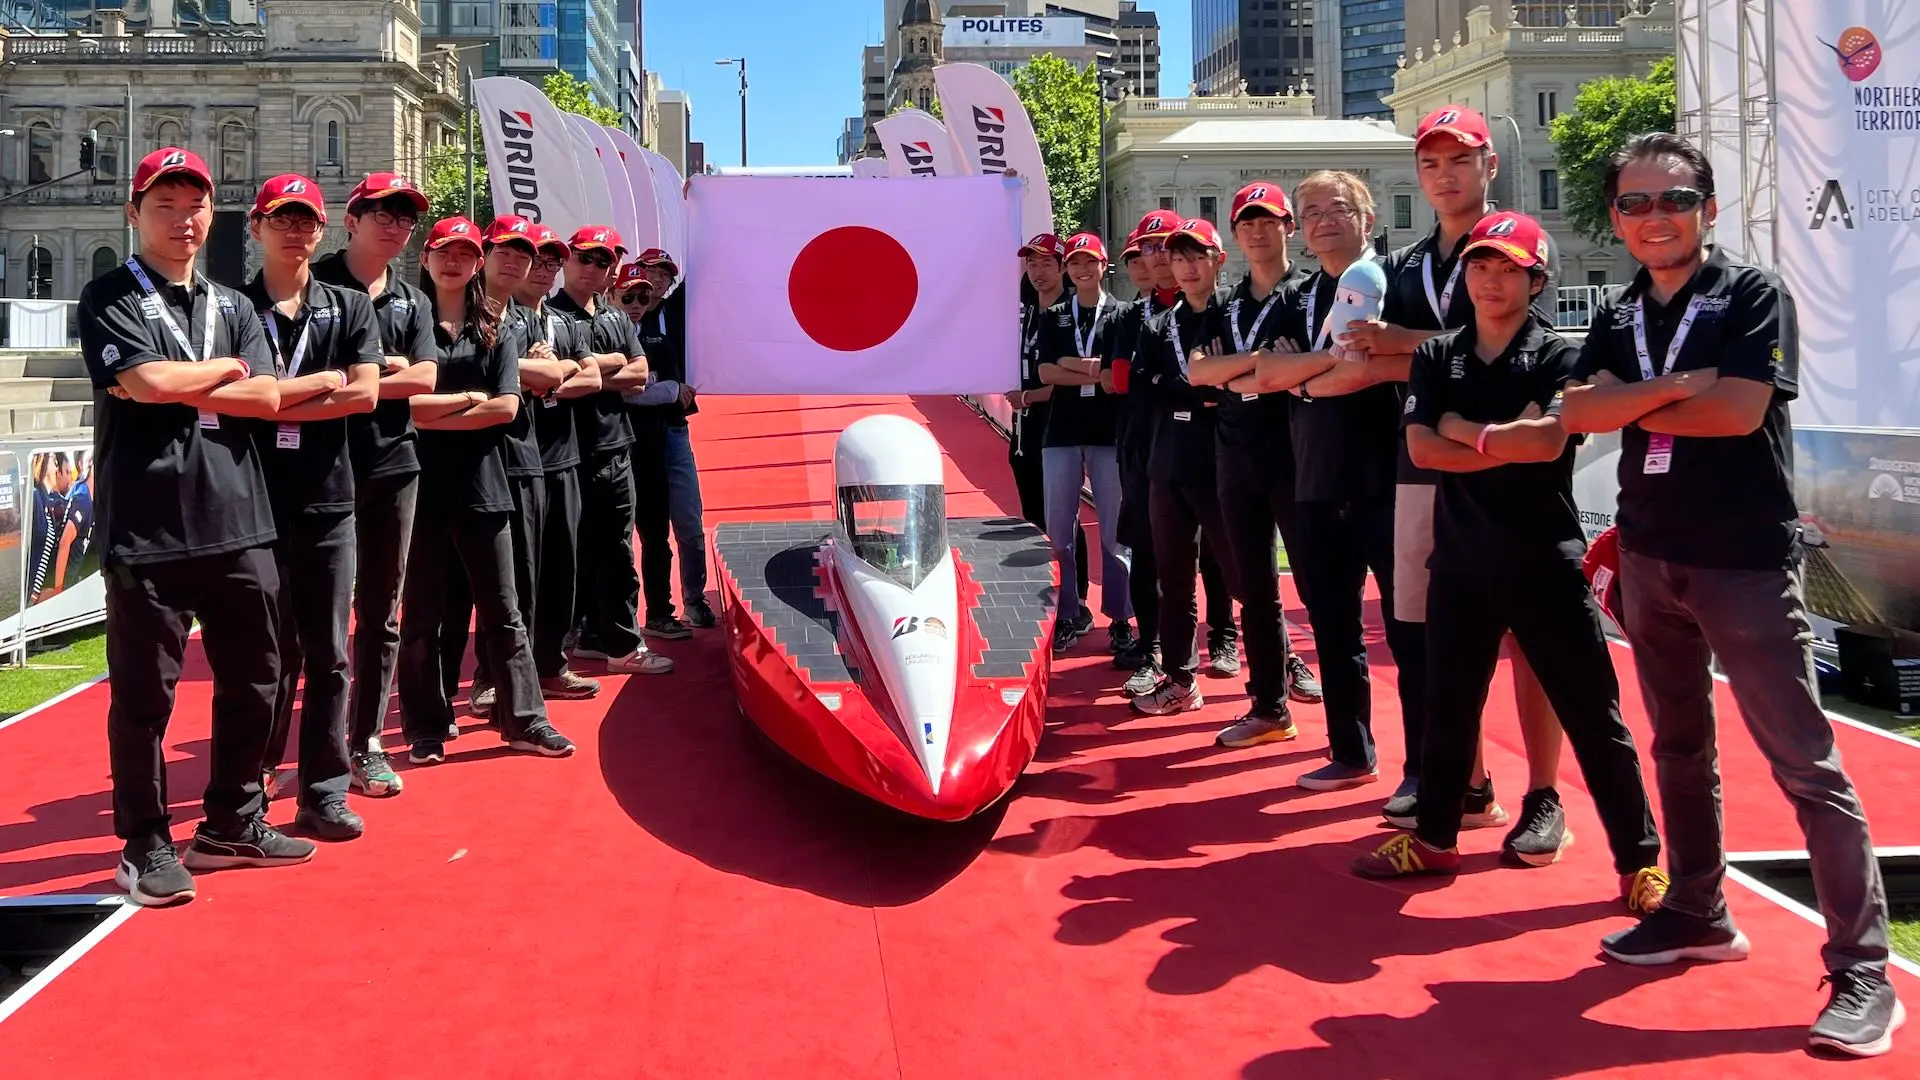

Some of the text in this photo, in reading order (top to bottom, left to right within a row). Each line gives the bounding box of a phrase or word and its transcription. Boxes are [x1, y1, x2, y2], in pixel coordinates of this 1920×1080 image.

[962, 19, 1043, 33] POLITES
[972, 104, 1007, 175] BRI
[1866, 189, 1900, 204] CITY
